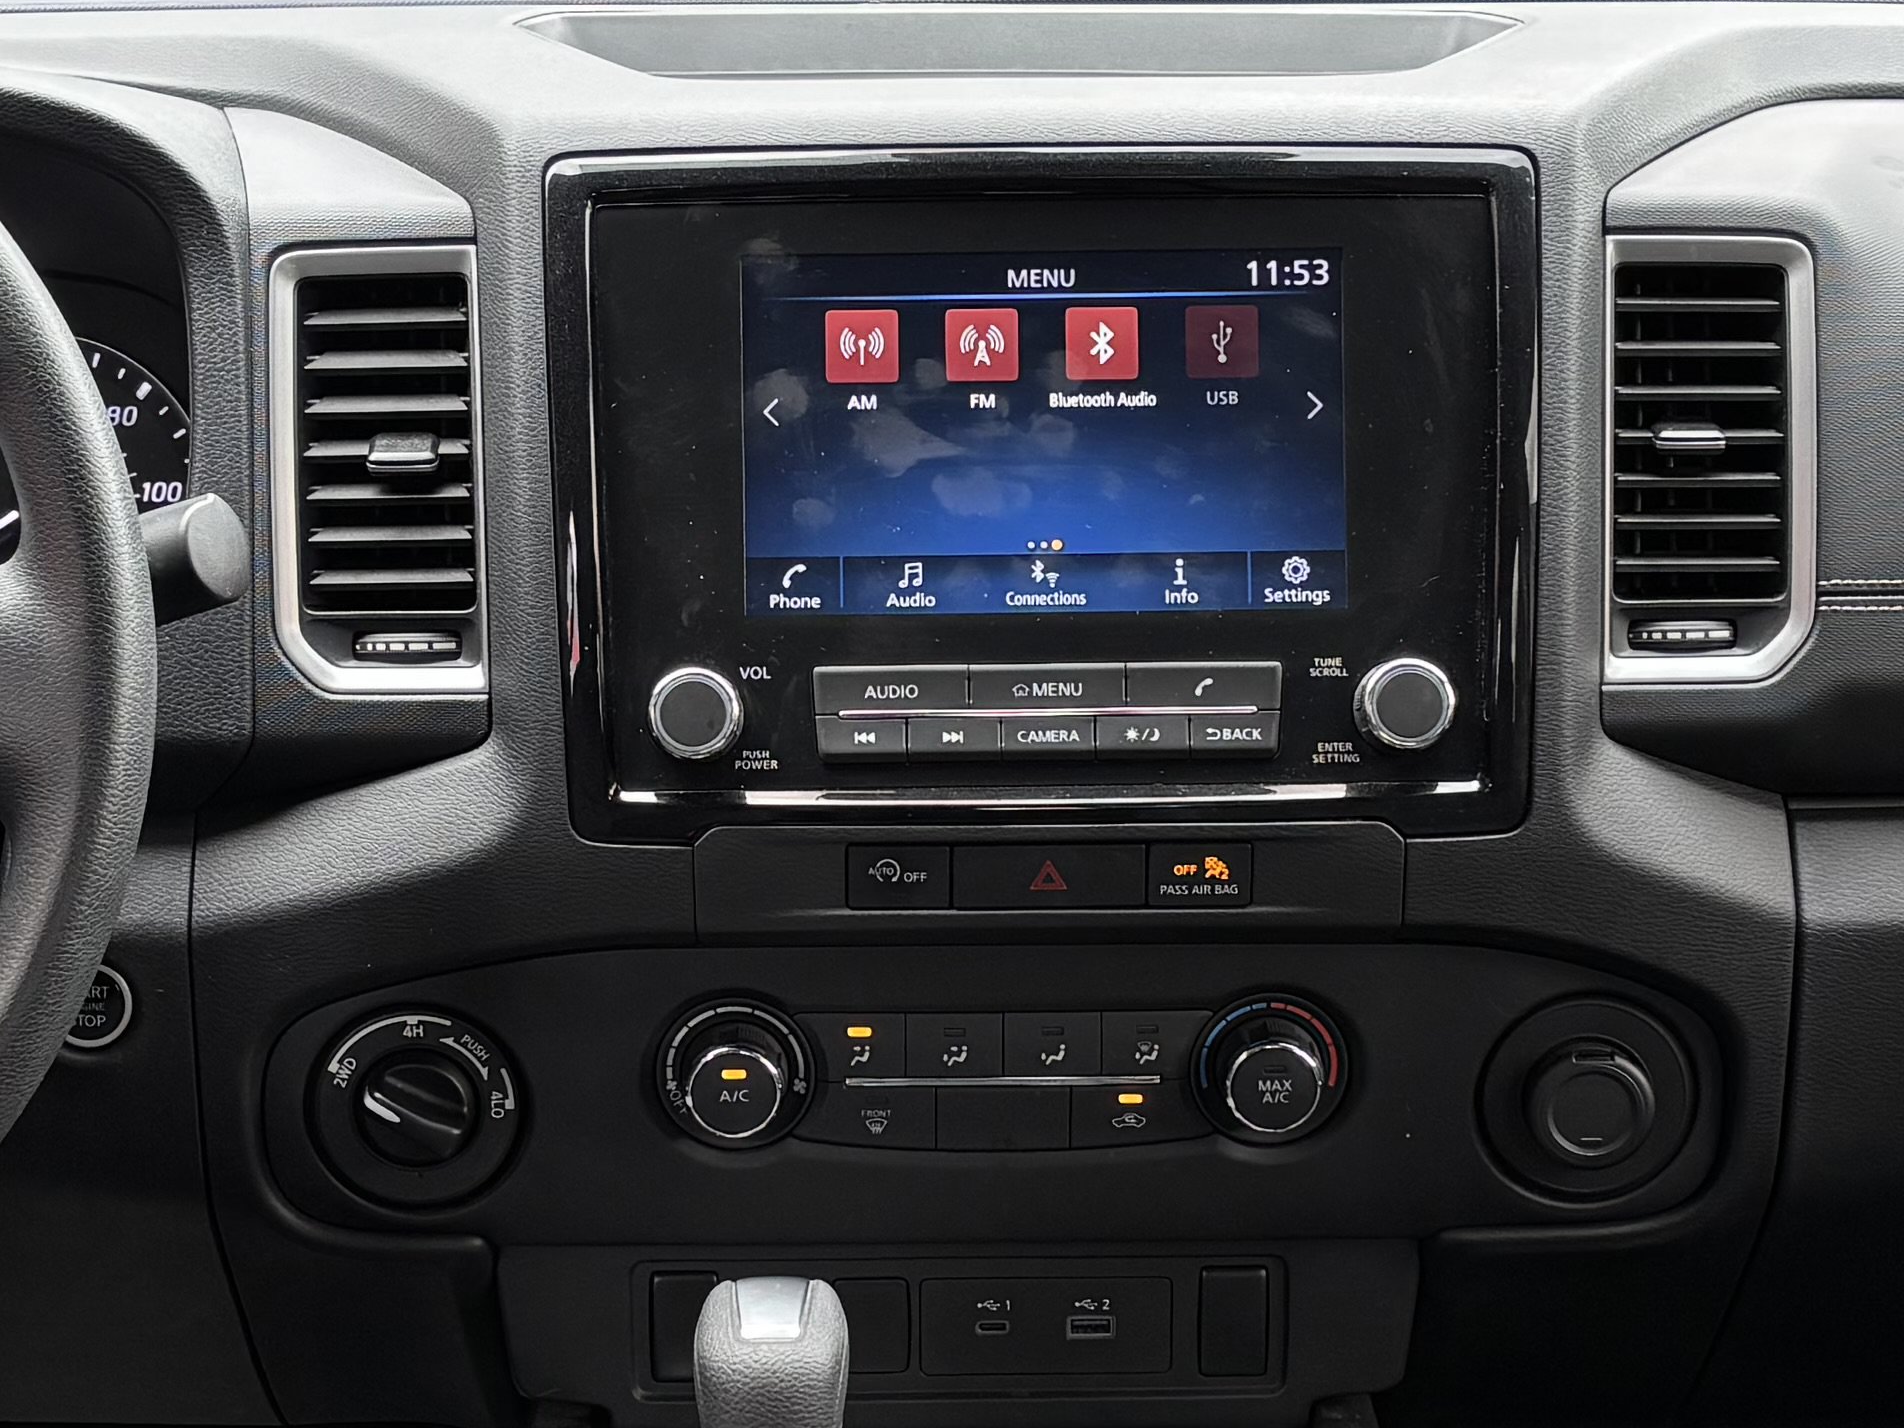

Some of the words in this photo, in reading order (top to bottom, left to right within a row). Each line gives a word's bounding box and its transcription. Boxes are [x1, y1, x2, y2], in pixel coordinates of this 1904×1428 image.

[1007, 270, 1076, 289] MENU
[1246, 259, 1330, 286] 11:53
[847, 395, 878, 410] AM
[970, 394, 996, 409] FM
[1049, 392, 1114, 409] Bluetooth
[1117, 392, 1158, 409] Audio
[1206, 391, 1239, 406] USB
[142, 481, 183, 502] 100
[769, 594, 821, 609] Phone
[886, 593, 937, 608] Audio
[1005, 591, 1087, 607] Connections
[1164, 588, 1199, 605] Info
[1264, 588, 1331, 606] Settings
[1314, 657, 1343, 667] TUNE
[739, 666, 772, 680] VOL
[1309, 667, 1349, 677] SCROLL
[864, 685, 919, 699] AUDIO
[1032, 683, 1083, 697] MENU
[1017, 730, 1080, 744] CAMERA
[1222, 727, 1262, 741] BACK
[743, 750, 770, 759] PUSH
[1318, 742, 1353, 753] ENTER
[734, 760, 779, 770] POWER
[1312, 753, 1360, 764] SETTING
[904, 872, 927, 883] OFF
[1174, 865, 1197, 876] OFF
[1160, 885, 1188, 895] PASS
[1192, 884, 1212, 895] AIR
[1215, 884, 1238, 895] BAG
[78, 1014, 106, 1027] TOP
[402, 1025, 424, 1038] 4H
[460, 1034, 490, 1062] PUSH
[333, 1057, 357, 1089] 2WD
[1258, 1079, 1293, 1092] MAX
[719, 1090, 750, 1103] A/C
[1262, 1091, 1290, 1104] A/C
[490, 1090, 505, 1119] 4LO
[861, 1109, 892, 1118] FRONT
[1102, 1299, 1110, 1311] 2
